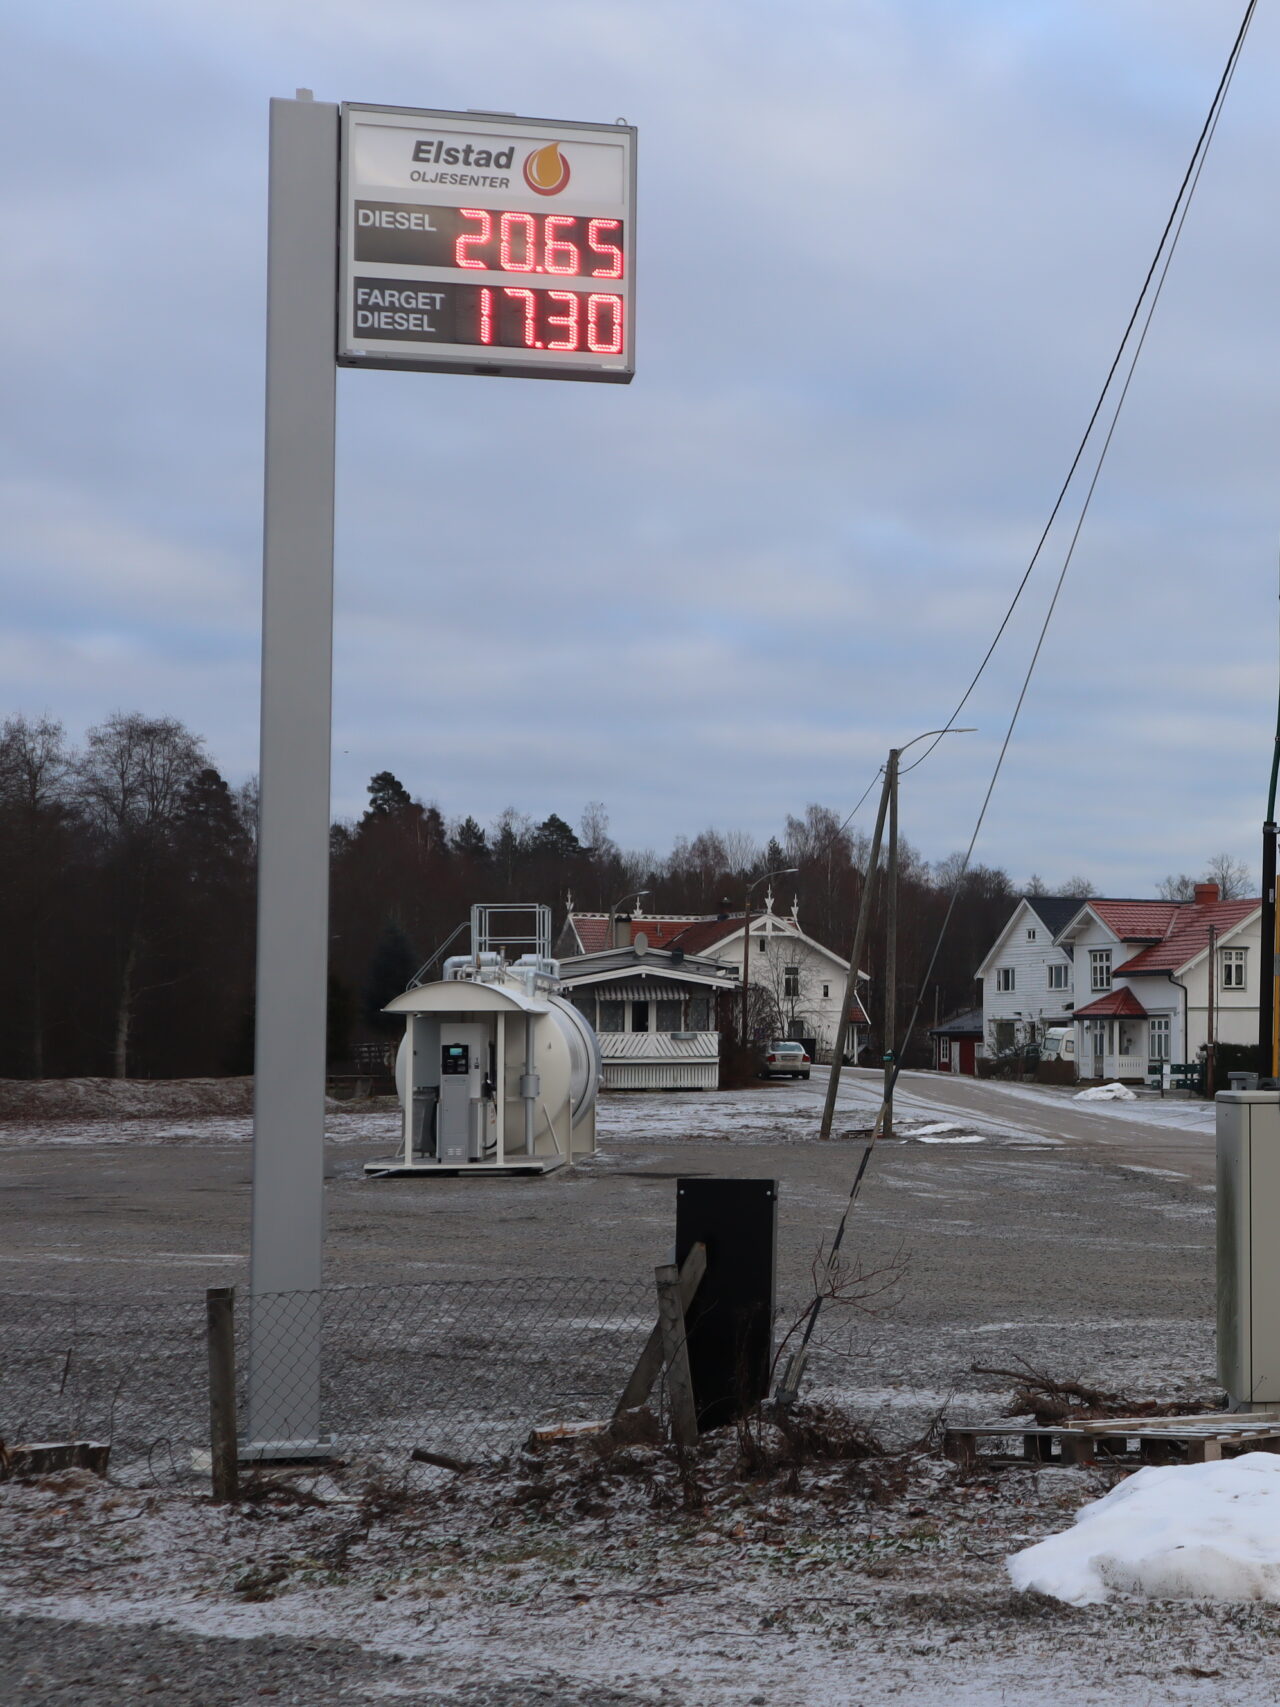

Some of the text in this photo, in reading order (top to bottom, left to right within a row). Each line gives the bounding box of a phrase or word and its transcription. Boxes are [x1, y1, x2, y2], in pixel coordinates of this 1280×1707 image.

[411, 139, 515, 170] Elstad
[409, 170, 510, 189] OLJESENTER
[357, 208, 437, 232] DIESEL
[455, 207, 622, 279] 20.65
[356, 287, 445, 311] FARGET
[356, 310, 436, 333] DIESEL
[480, 287, 623, 353] 17.30
